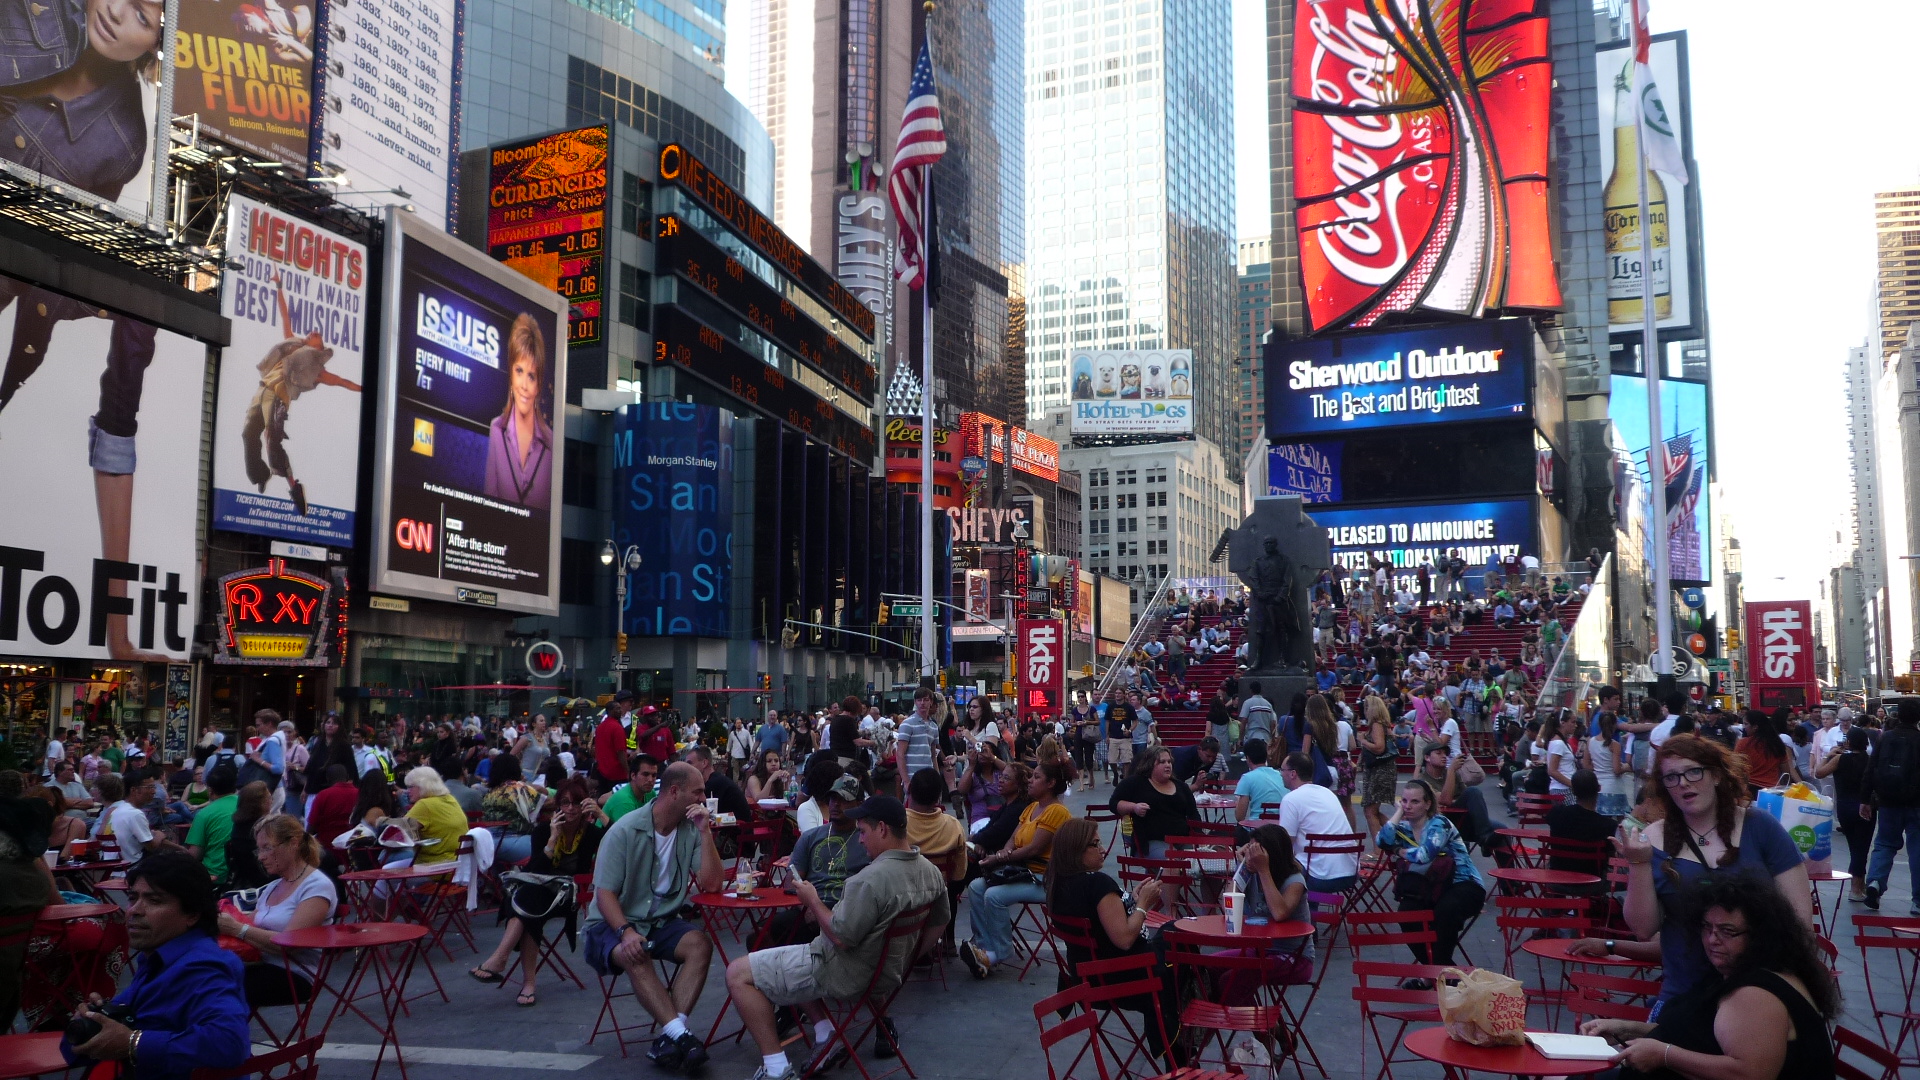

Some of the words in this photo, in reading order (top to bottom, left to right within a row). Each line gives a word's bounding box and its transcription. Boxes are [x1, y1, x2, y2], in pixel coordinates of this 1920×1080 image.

[174, 29, 269, 81] BURN
[270, 64, 304, 88] THE
[202, 73, 312, 125] FLOOR
[228, 116, 266, 132] Ballroom.
[266, 122, 308, 138] Reinvented.
[408, 150, 434, 173] mind.
[1310, 4, 1407, 286] Coca-Cola
[490, 168, 606, 208] CURRENCIES
[240, 203, 249, 231] THE
[504, 206, 534, 222] PRICE
[1605, 211, 1666, 232] Corna
[239, 234, 249, 249] IN
[247, 207, 363, 290] HEIGHTS
[491, 227, 540, 244] JAPANESE
[543, 222, 563, 236] YEN
[559, 231, 598, 252] -0.06
[749, 208, 803, 280] MESSAGE
[278, 268, 310, 297] TONY
[317, 282, 359, 314] AWARD
[557, 275, 596, 296] -0.06
[886, 239, 894, 310] Chocolate
[234, 277, 278, 327] BEST
[288, 295, 360, 352] MUSICAL
[417, 292, 500, 358] ISSUES
[886, 312, 894, 346] Milk
[416, 347, 444, 372] EVERY
[445, 360, 472, 383] NIGHT
[1289, 351, 1402, 390] Sherwood
[1408, 346, 1503, 379] Outdoor
[1077, 400, 1130, 419] HOTEL
[1140, 403, 1187, 419] DOGS
[1310, 394, 1338, 418] The
[1342, 391, 1375, 419] Best
[1378, 388, 1407, 414] and
[1411, 383, 1480, 413] Brightest
[885, 418, 949, 444] Reee's
[647, 455, 684, 467] Morgan
[685, 456, 717, 470] Stanley
[1029, 446, 1056, 467] PLAZA
[395, 517, 434, 554] CNN
[469, 537, 483, 552] the
[1389, 523, 1408, 543] TO
[1412, 519, 1494, 542] ANNOUNCE
[296, 547, 311, 557] CBS
[0, 546, 80, 645] To
[88, 558, 188, 652] Fit
[230, 583, 318, 625] RXY
[242, 641, 304, 652] DELICATESSEN
[1029, 624, 1057, 685] tkts
[1763, 607, 1802, 680] tkts
[534, 653, 557, 671] W
